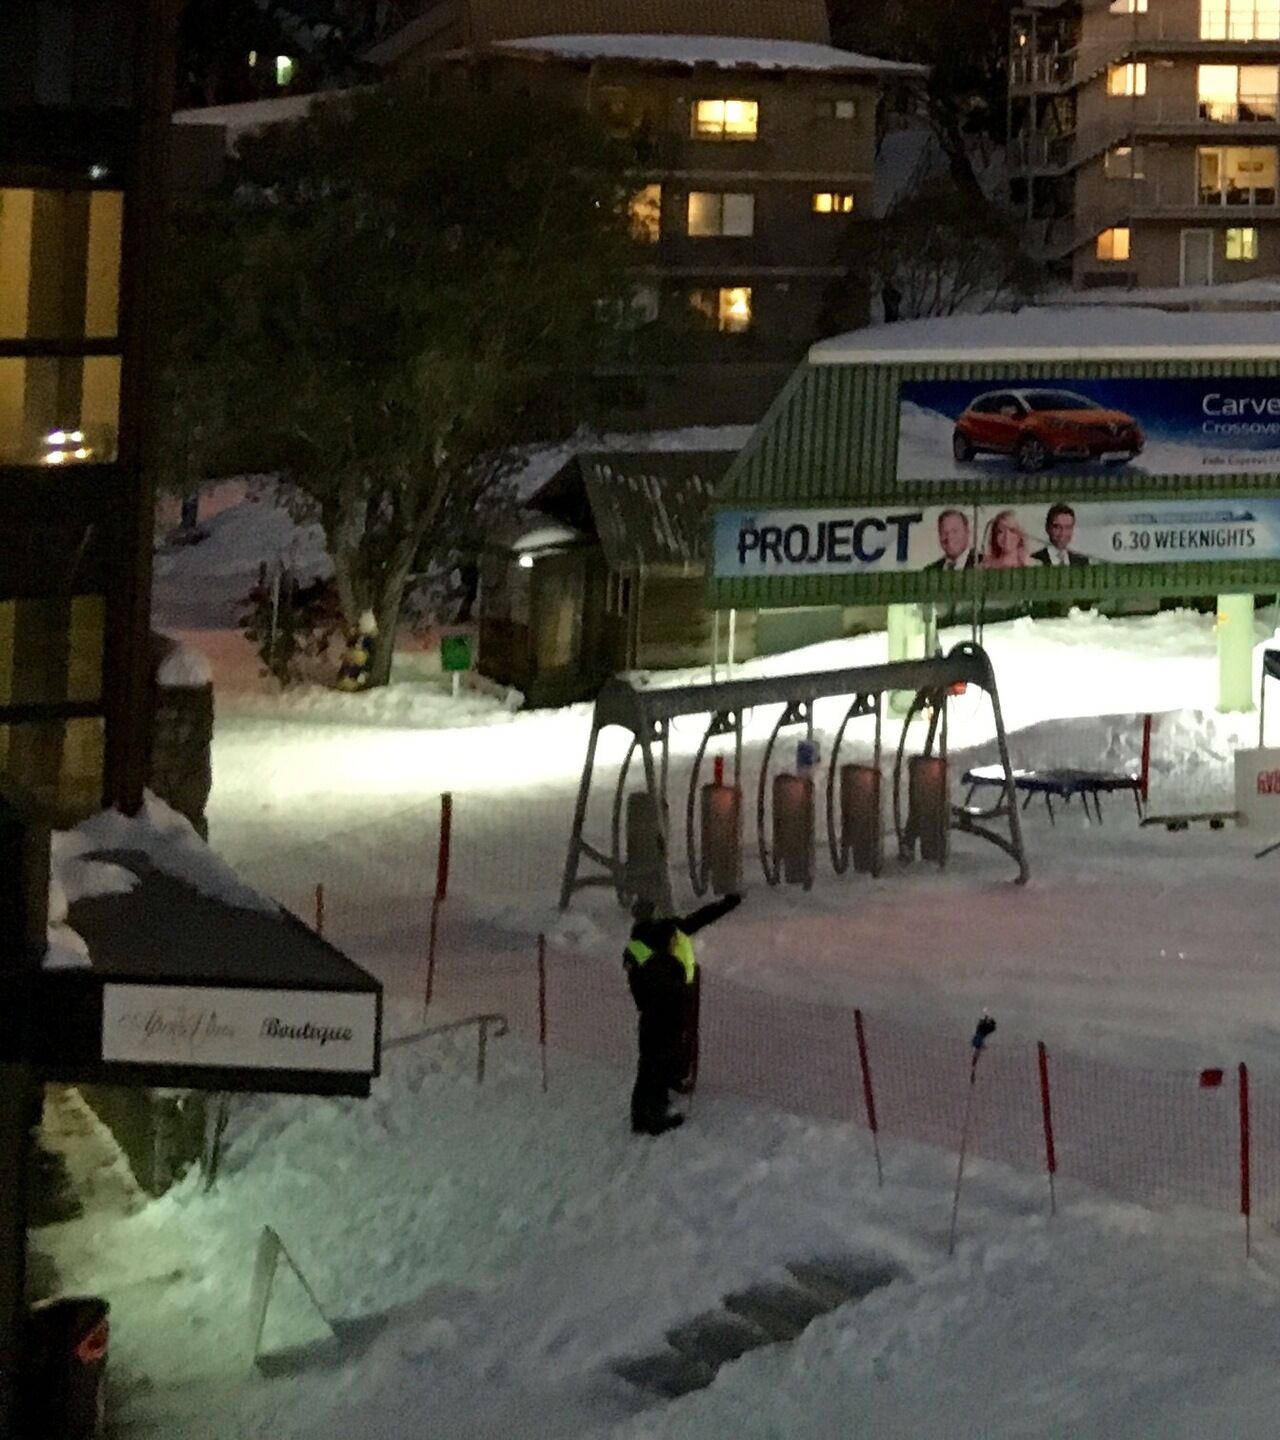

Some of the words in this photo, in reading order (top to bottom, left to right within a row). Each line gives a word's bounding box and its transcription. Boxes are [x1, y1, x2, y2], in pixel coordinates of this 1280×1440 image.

[738, 513, 923, 564] PROJECT
[1111, 531, 1149, 551] 6.30
[1154, 527, 1256, 550] WEEKNIGHTS
